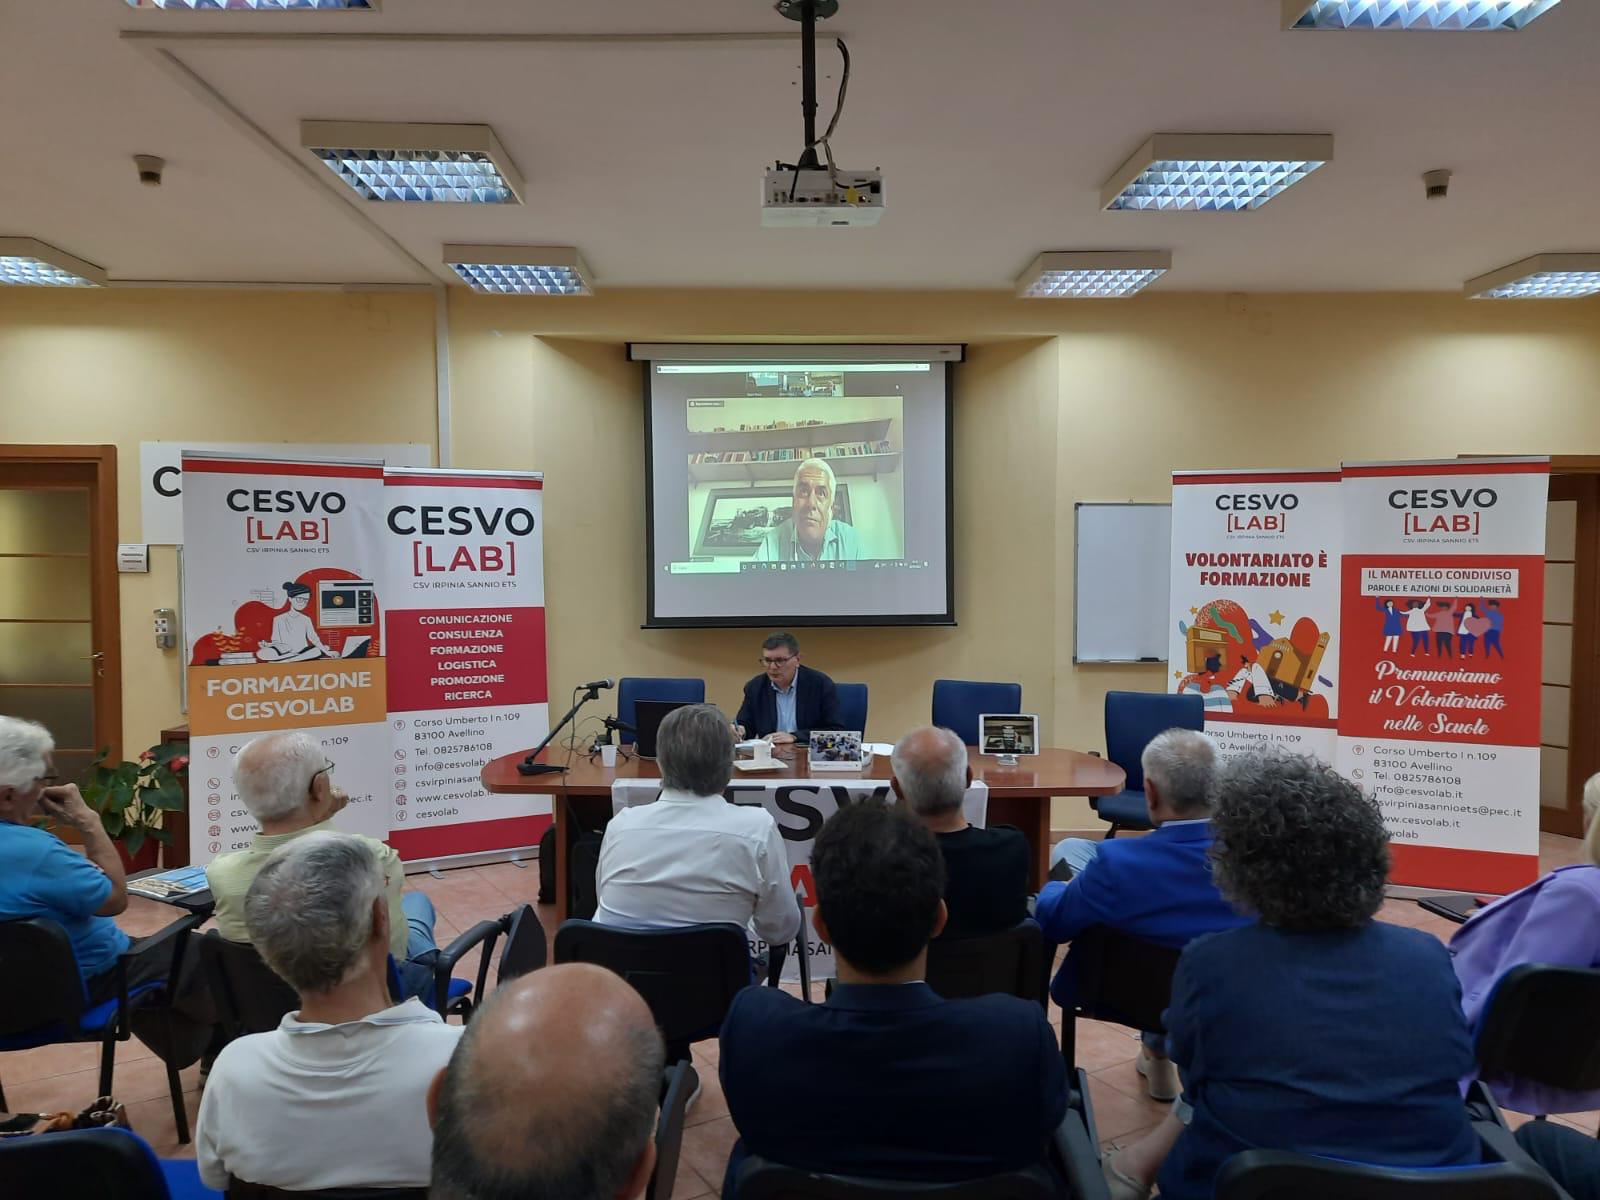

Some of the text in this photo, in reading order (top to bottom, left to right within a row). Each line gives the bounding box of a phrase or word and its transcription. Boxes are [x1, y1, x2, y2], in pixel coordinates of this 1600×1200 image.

[226, 488, 346, 514] CESVO
[1215, 493, 1299, 511] CESVO
[1388, 488, 1498, 510] CESVO
[387, 505, 535, 537] CESVO
[1227, 513, 1285, 533] [LAB]
[1404, 511, 1480, 536] [LAB]
[247, 516, 329, 544] [LAB]
[413, 541, 516, 577] [LAB]
[1185, 550, 1328, 568] VOLONTARIATO È
[1200, 571, 1311, 587] FORMAZIONE
[1368, 570, 1512, 581] IL MANTELLO CONDIVISO
[432, 581, 465, 589] IRPINIA
[1367, 584, 1400, 592] PAROLE
[1402, 584, 1408, 592] E
[1410, 584, 1440, 592] AZIONI
[1454, 583, 1512, 594] SOLIDARIETÀ
[419, 614, 513, 625] COMUNICAZIONE
[429, 629, 504, 640] CONSULENZA
[430, 644, 504, 655] FORMAZIONE
[438, 659, 496, 671] LOGISTICA
[1375, 660, 1503, 684] Promuoviamo
[207, 671, 372, 697] FORMAZIONE
[431, 674, 505, 686] PROMOZIONE
[444, 690, 493, 701] RICERCA
[1368, 685, 1507, 710] il Volontariato
[226, 697, 355, 721] CESVOLAB
[414, 719, 443, 728] Corso
[445, 715, 488, 726] Umberto
[1383, 713, 1490, 735] nelle Scuole
[321, 736, 349, 746] n.109
[414, 728, 485, 741] 83100 Avellino
[1227, 730, 1268, 741] Umberto
[433, 742, 493, 755] 0825786108
[1373, 745, 1405, 756] Corso
[1408, 748, 1458, 759] Umberto
[1373, 759, 1453, 772] 83100 Avellino
[1394, 773, 1462, 785] 0825786108
[348, 794, 373, 803] ec.it
[1373, 785, 1464, 799] info@cesvolab.it
[415, 807, 459, 819] cesvolab
[1377, 799, 1522, 817] svirpiniasannioets@pec.it
[1382, 814, 1461, 828] ww.cesvolab.it
